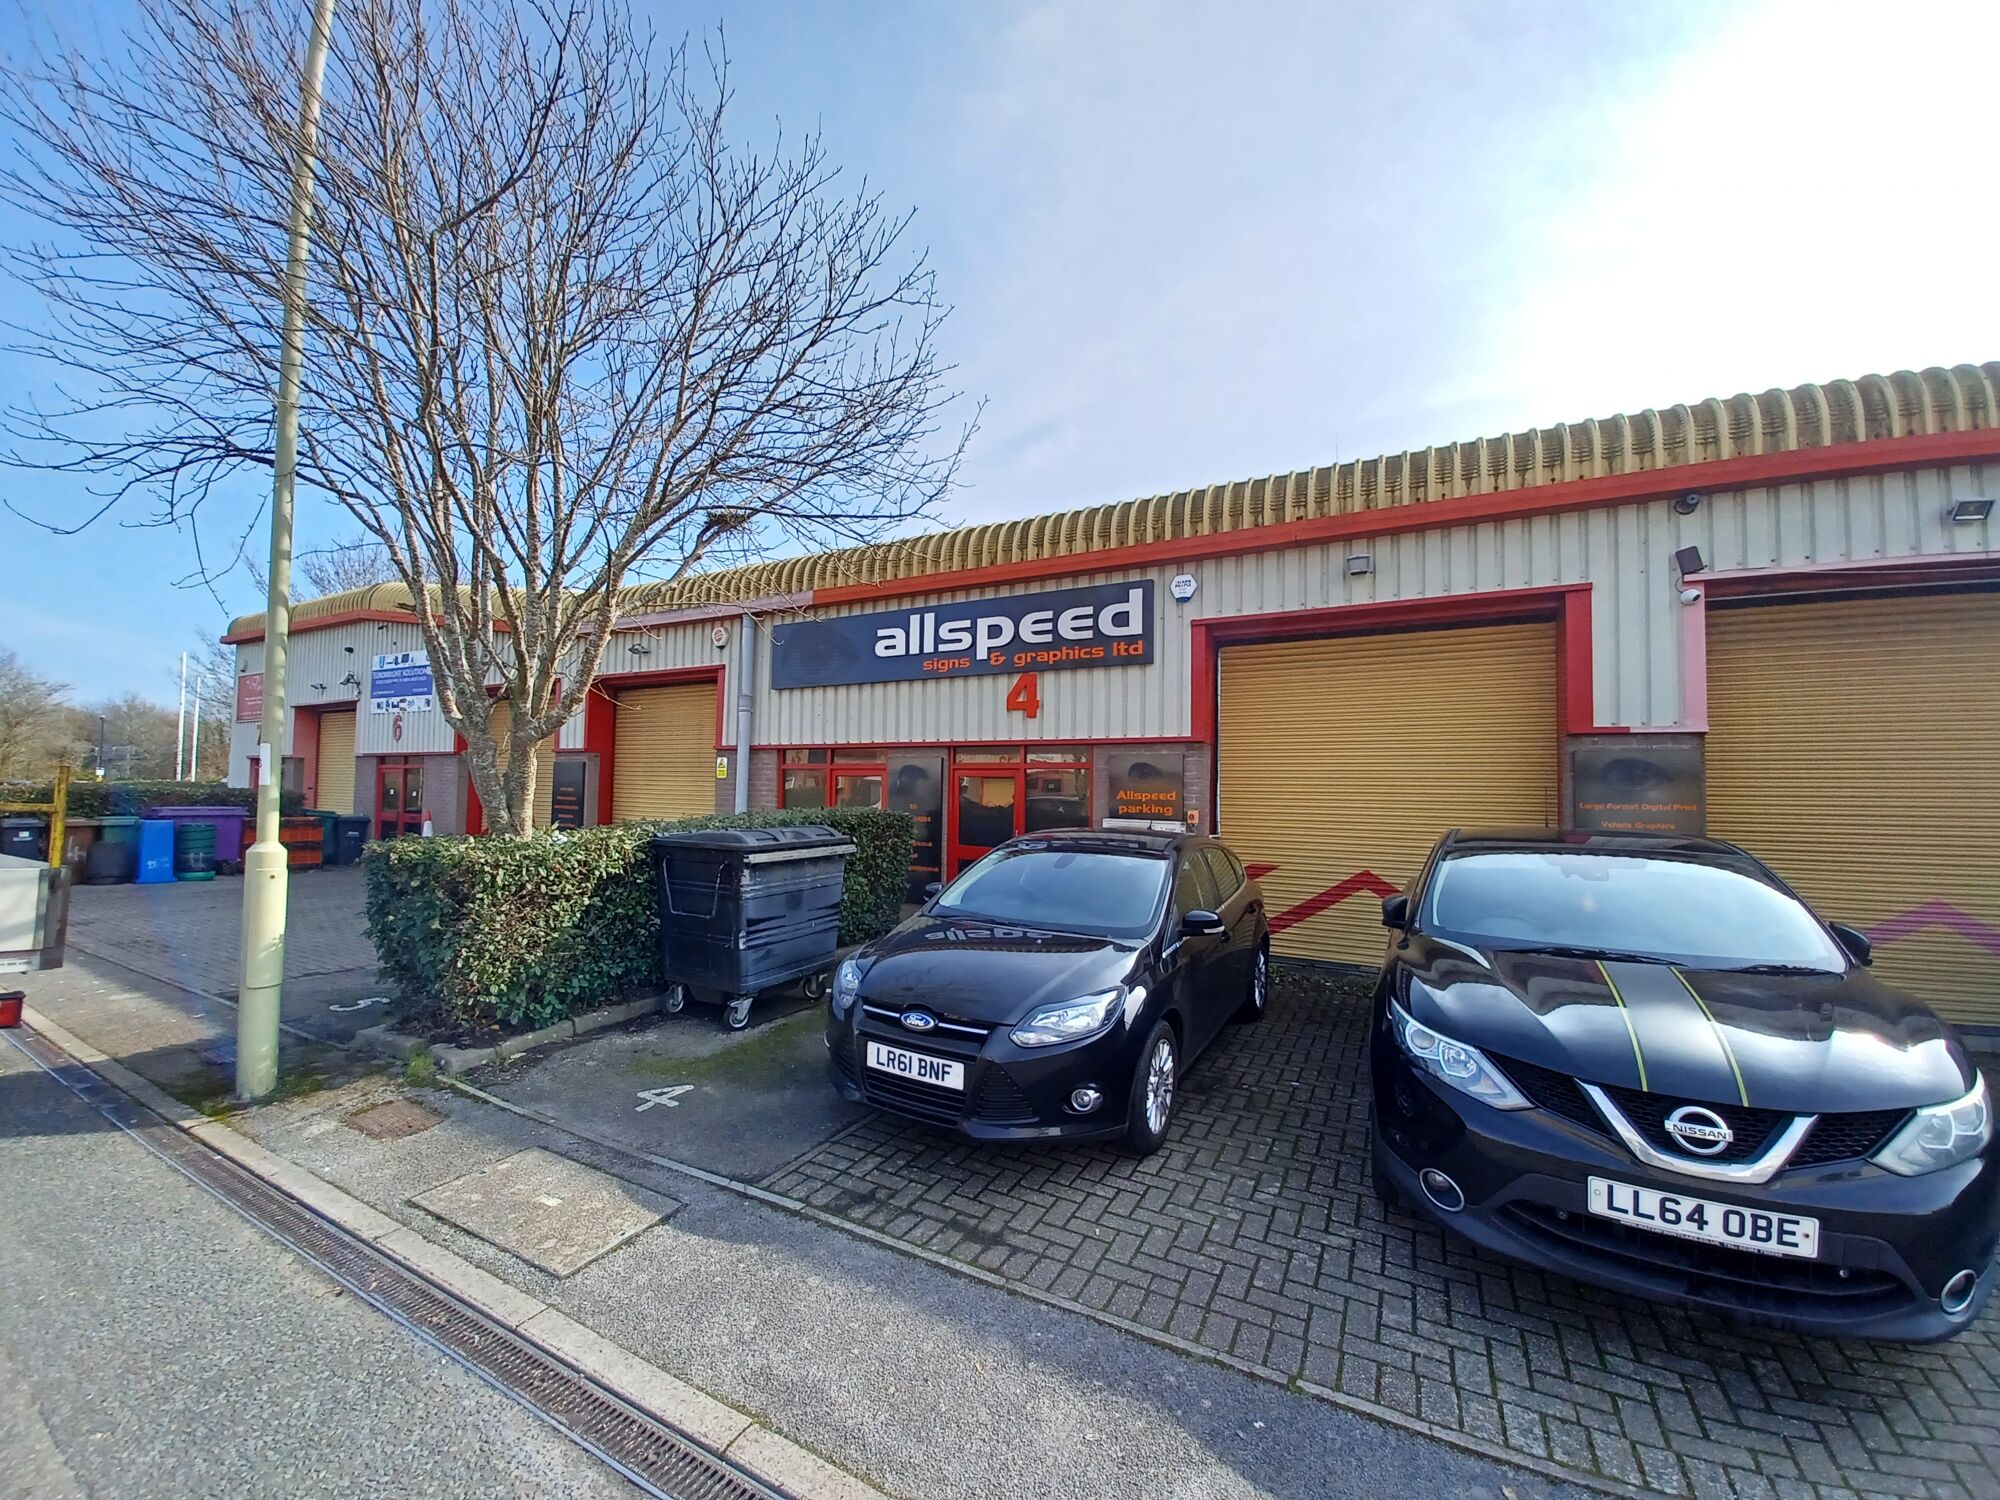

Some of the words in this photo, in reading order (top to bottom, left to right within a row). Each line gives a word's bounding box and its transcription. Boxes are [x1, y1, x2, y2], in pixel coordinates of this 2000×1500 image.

[875, 588, 1144, 660] allspeed
[923, 656, 970, 673] signs
[990, 652, 1006, 666] &
[1013, 645, 1104, 668] graphics
[1112, 641, 1143, 657] ltd
[1006, 673, 1040, 719] 4
[392, 715, 403, 742] 6
[1116, 789, 1177, 802] Allspeed
[1579, 803, 1604, 812] Large
[1606, 803, 1640, 811] Format
[1641, 803, 1672, 812] Digital
[1118, 804, 1173, 816] parking
[1601, 821, 1633, 829] Vehicle
[1634, 822, 1676, 830] Graphics
[876, 1046, 913, 1074] LR61
[917, 1057, 953, 1082] BNF
[1672, 1123, 1728, 1140] NISSAN
[1607, 1184, 1709, 1232] LL64
[1722, 1209, 1801, 1248] OBE
